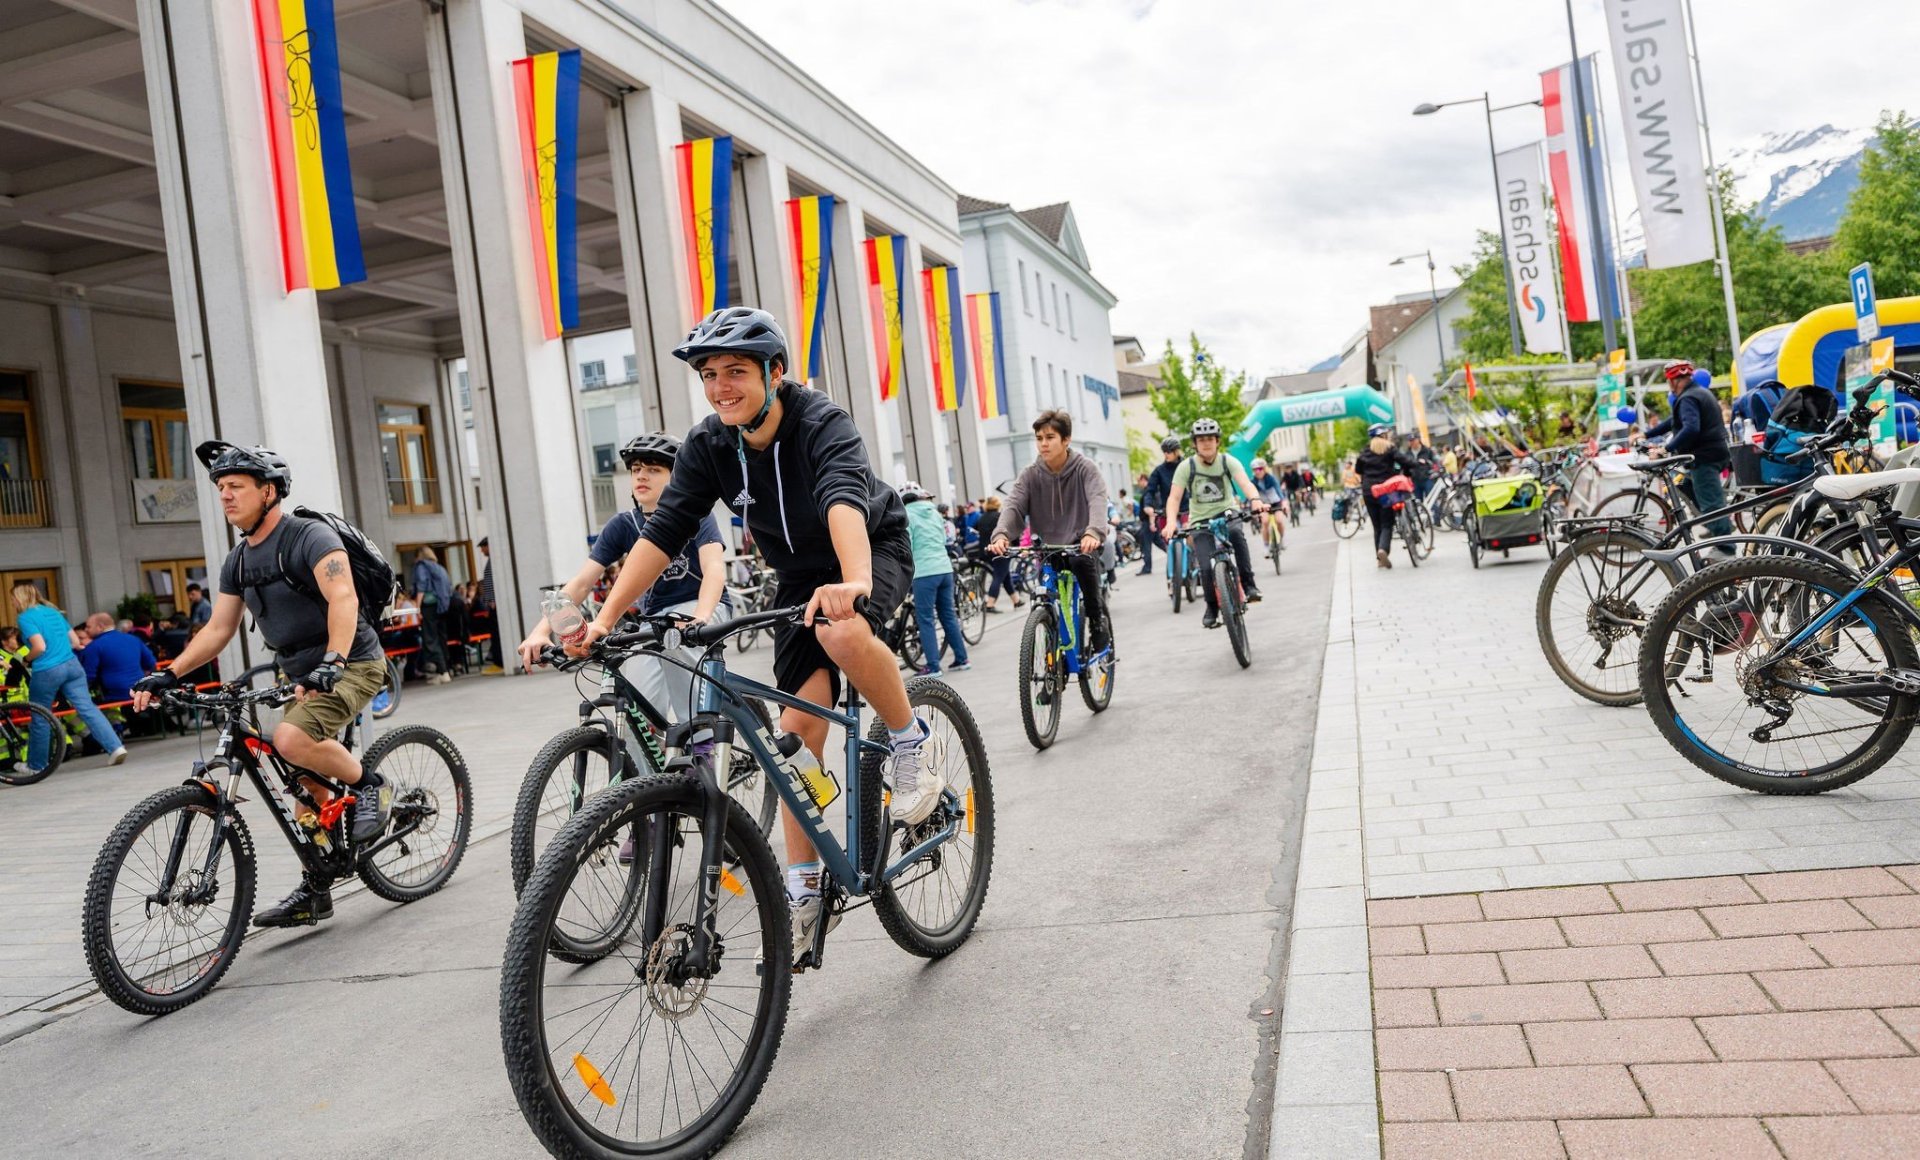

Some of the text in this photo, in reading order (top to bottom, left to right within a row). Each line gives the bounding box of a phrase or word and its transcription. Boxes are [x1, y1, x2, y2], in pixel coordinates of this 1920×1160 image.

[1856, 276, 1868, 313] P
[1285, 401, 1342, 420] SWICA
[924, 689, 954, 703] KENDA
[435, 737, 461, 766] MAXXIS
[230, 815, 250, 856] AXXIS
